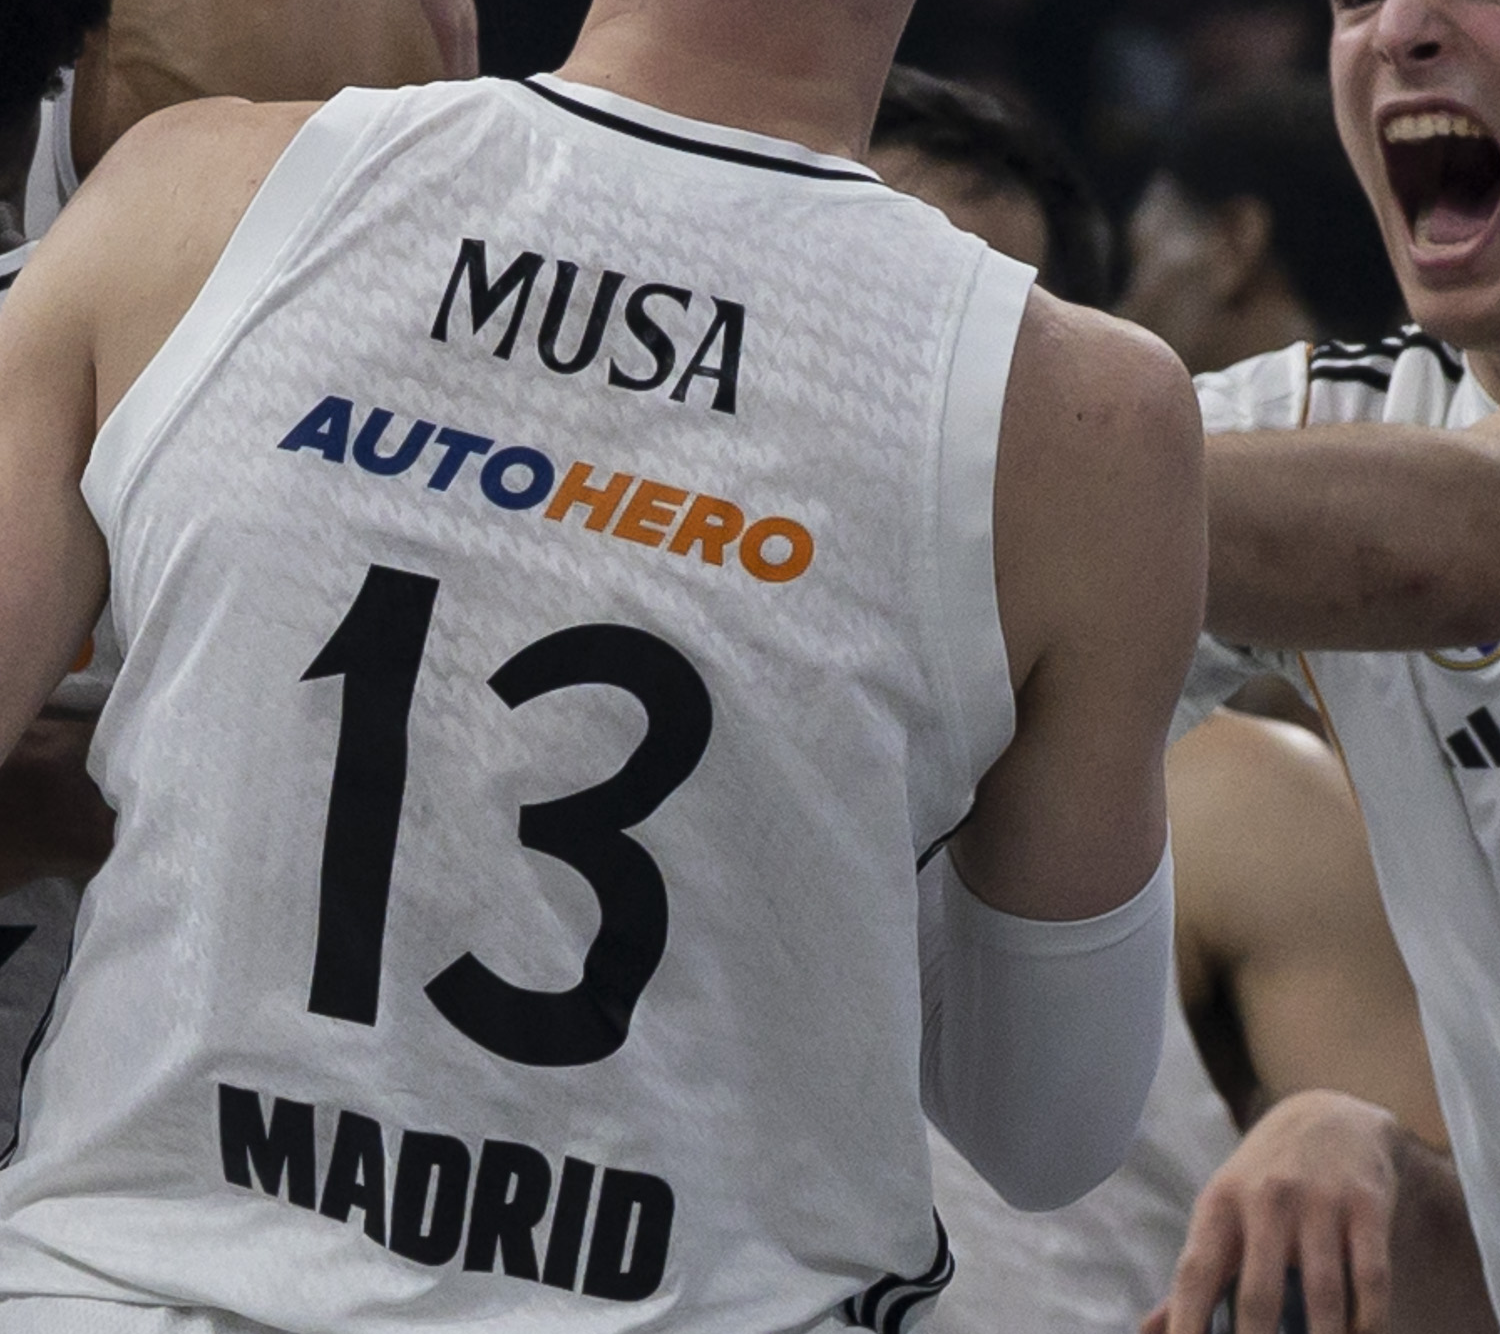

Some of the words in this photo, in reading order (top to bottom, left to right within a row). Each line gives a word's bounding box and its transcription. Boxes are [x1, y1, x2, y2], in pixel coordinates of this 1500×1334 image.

[430, 238, 746, 415] MUSA
[277, 395, 814, 584] AUTOHERO
[299, 562, 714, 1068] 13
[218, 1082, 677, 1303] MADRID
